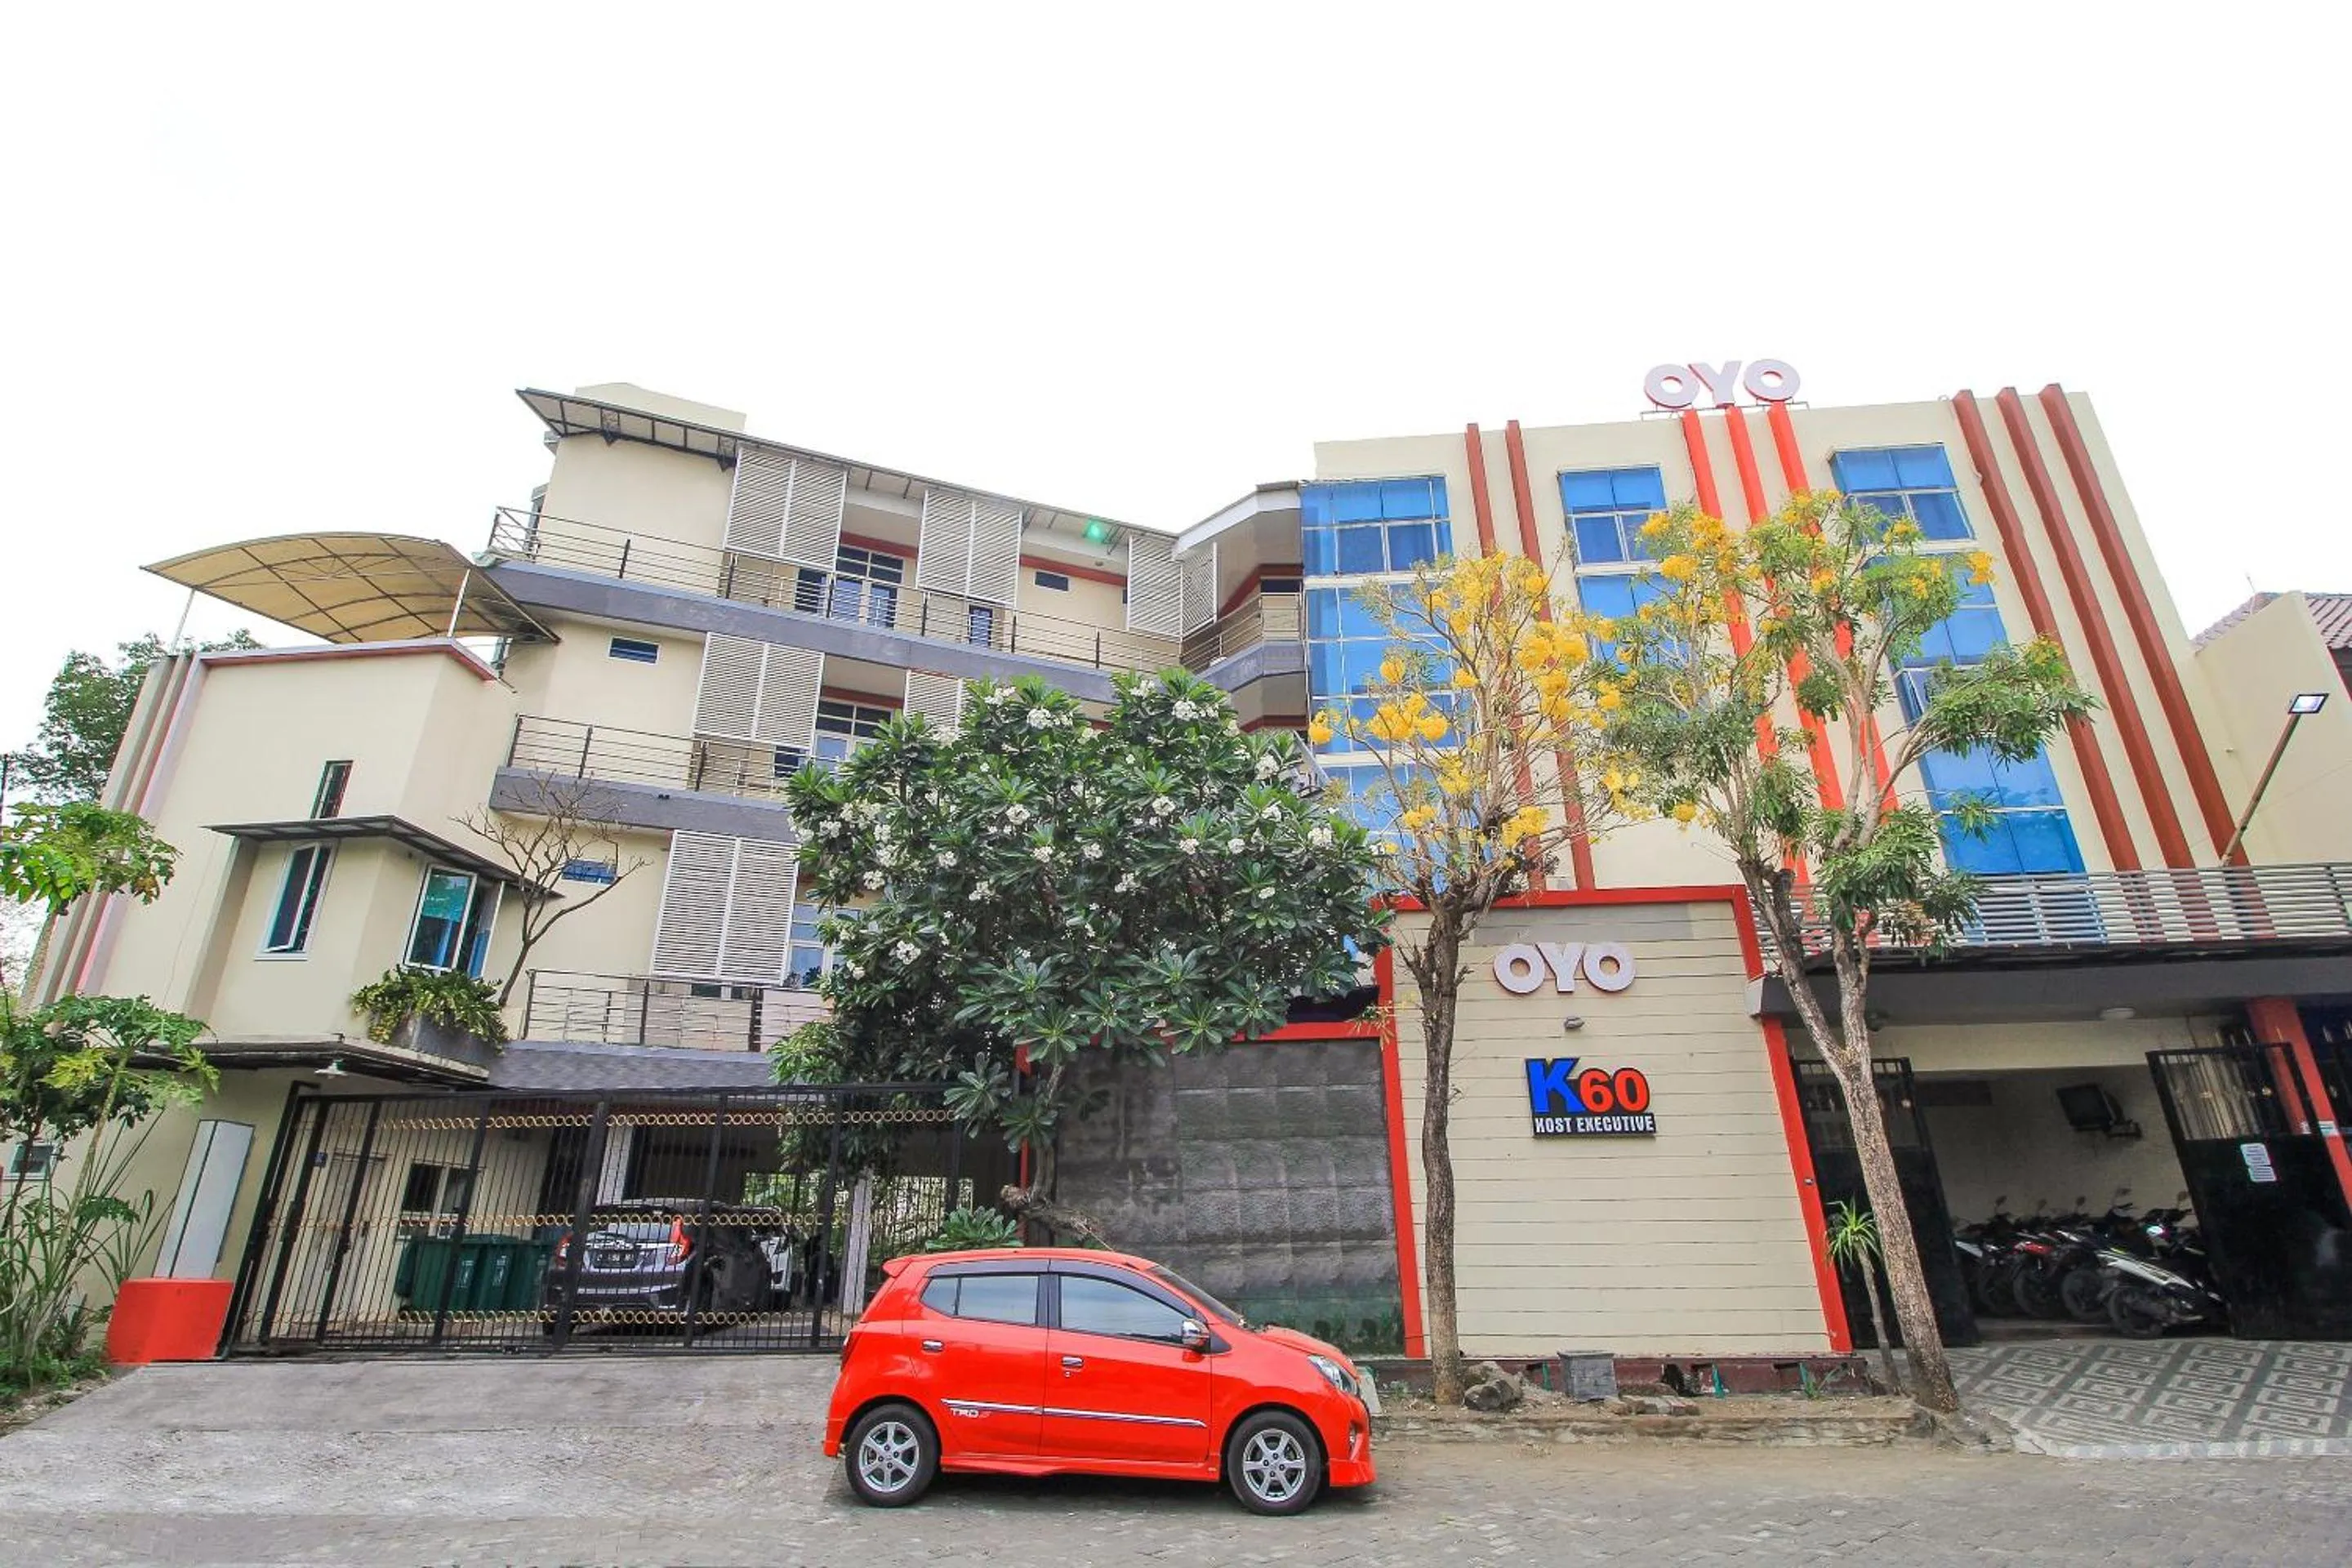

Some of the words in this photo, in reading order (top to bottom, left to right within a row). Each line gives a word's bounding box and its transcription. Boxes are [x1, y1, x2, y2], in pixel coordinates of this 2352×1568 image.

[1644, 359, 1801, 409] OYO
[1494, 942, 1636, 994] OYO
[1526, 1058, 1650, 1113] K60
[1577, 1116, 1655, 1133] EXECUTIVE
